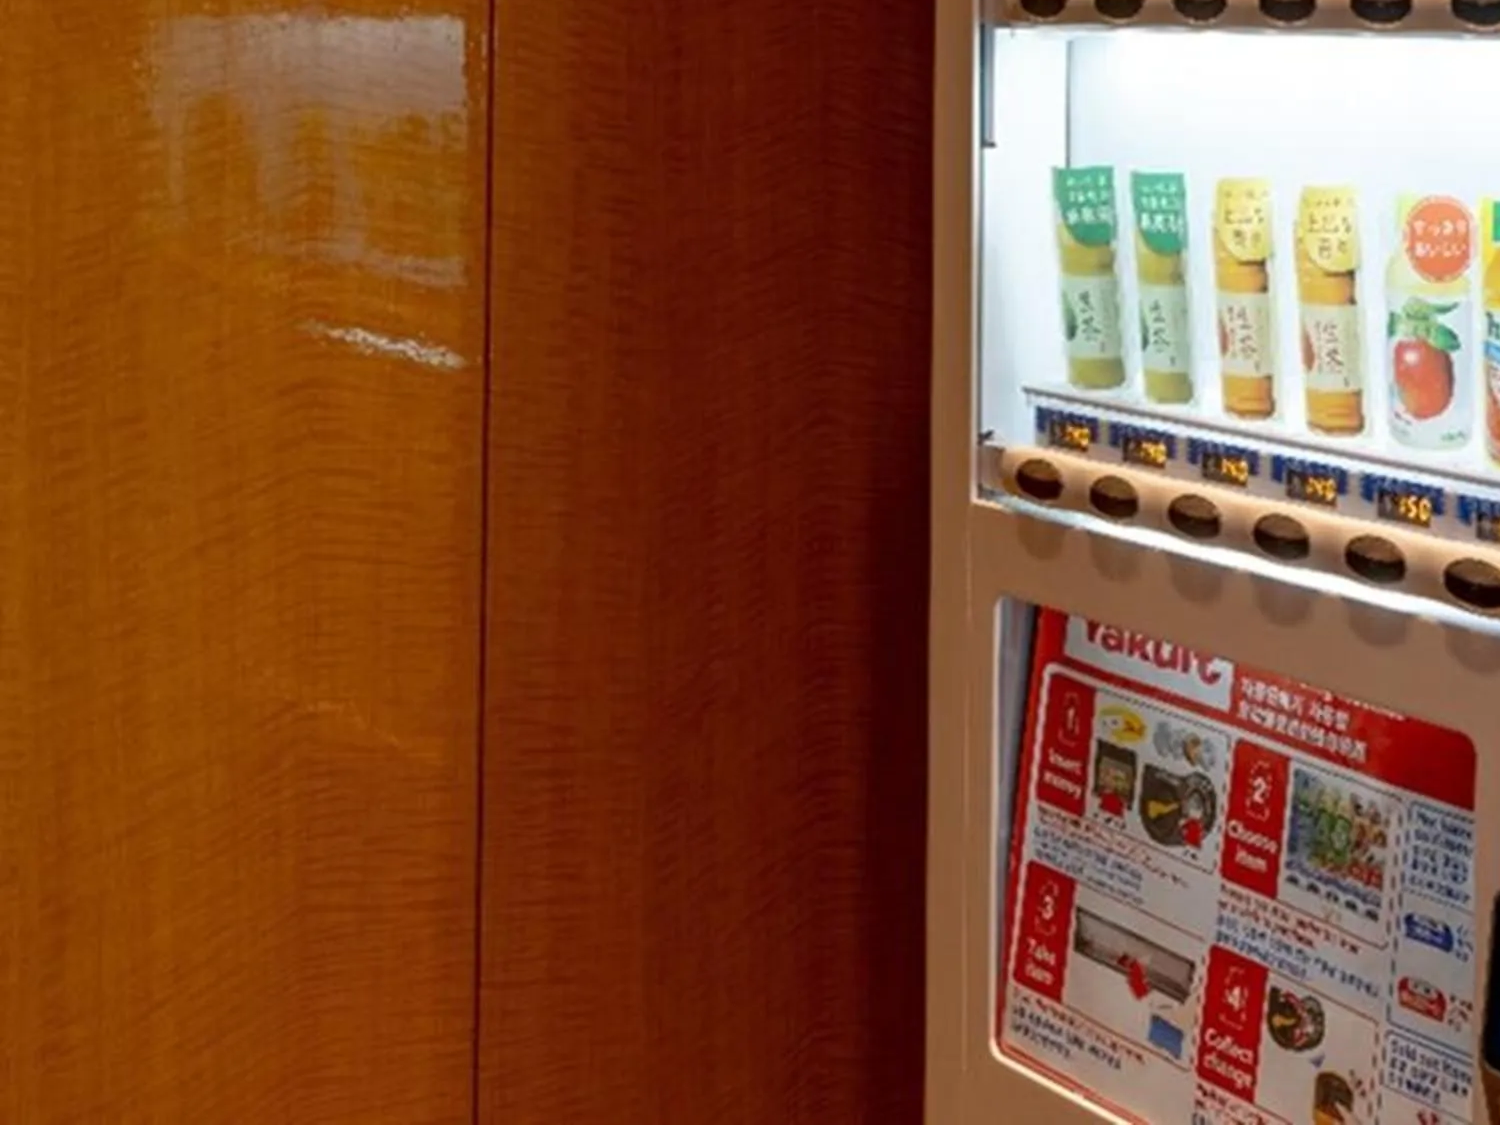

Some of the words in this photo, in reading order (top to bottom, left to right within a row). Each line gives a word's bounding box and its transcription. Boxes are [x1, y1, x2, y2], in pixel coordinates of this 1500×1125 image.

[1400, 496, 1432, 522] 150
[1251, 776, 1268, 803] 2
[1041, 895, 1054, 920] 3
